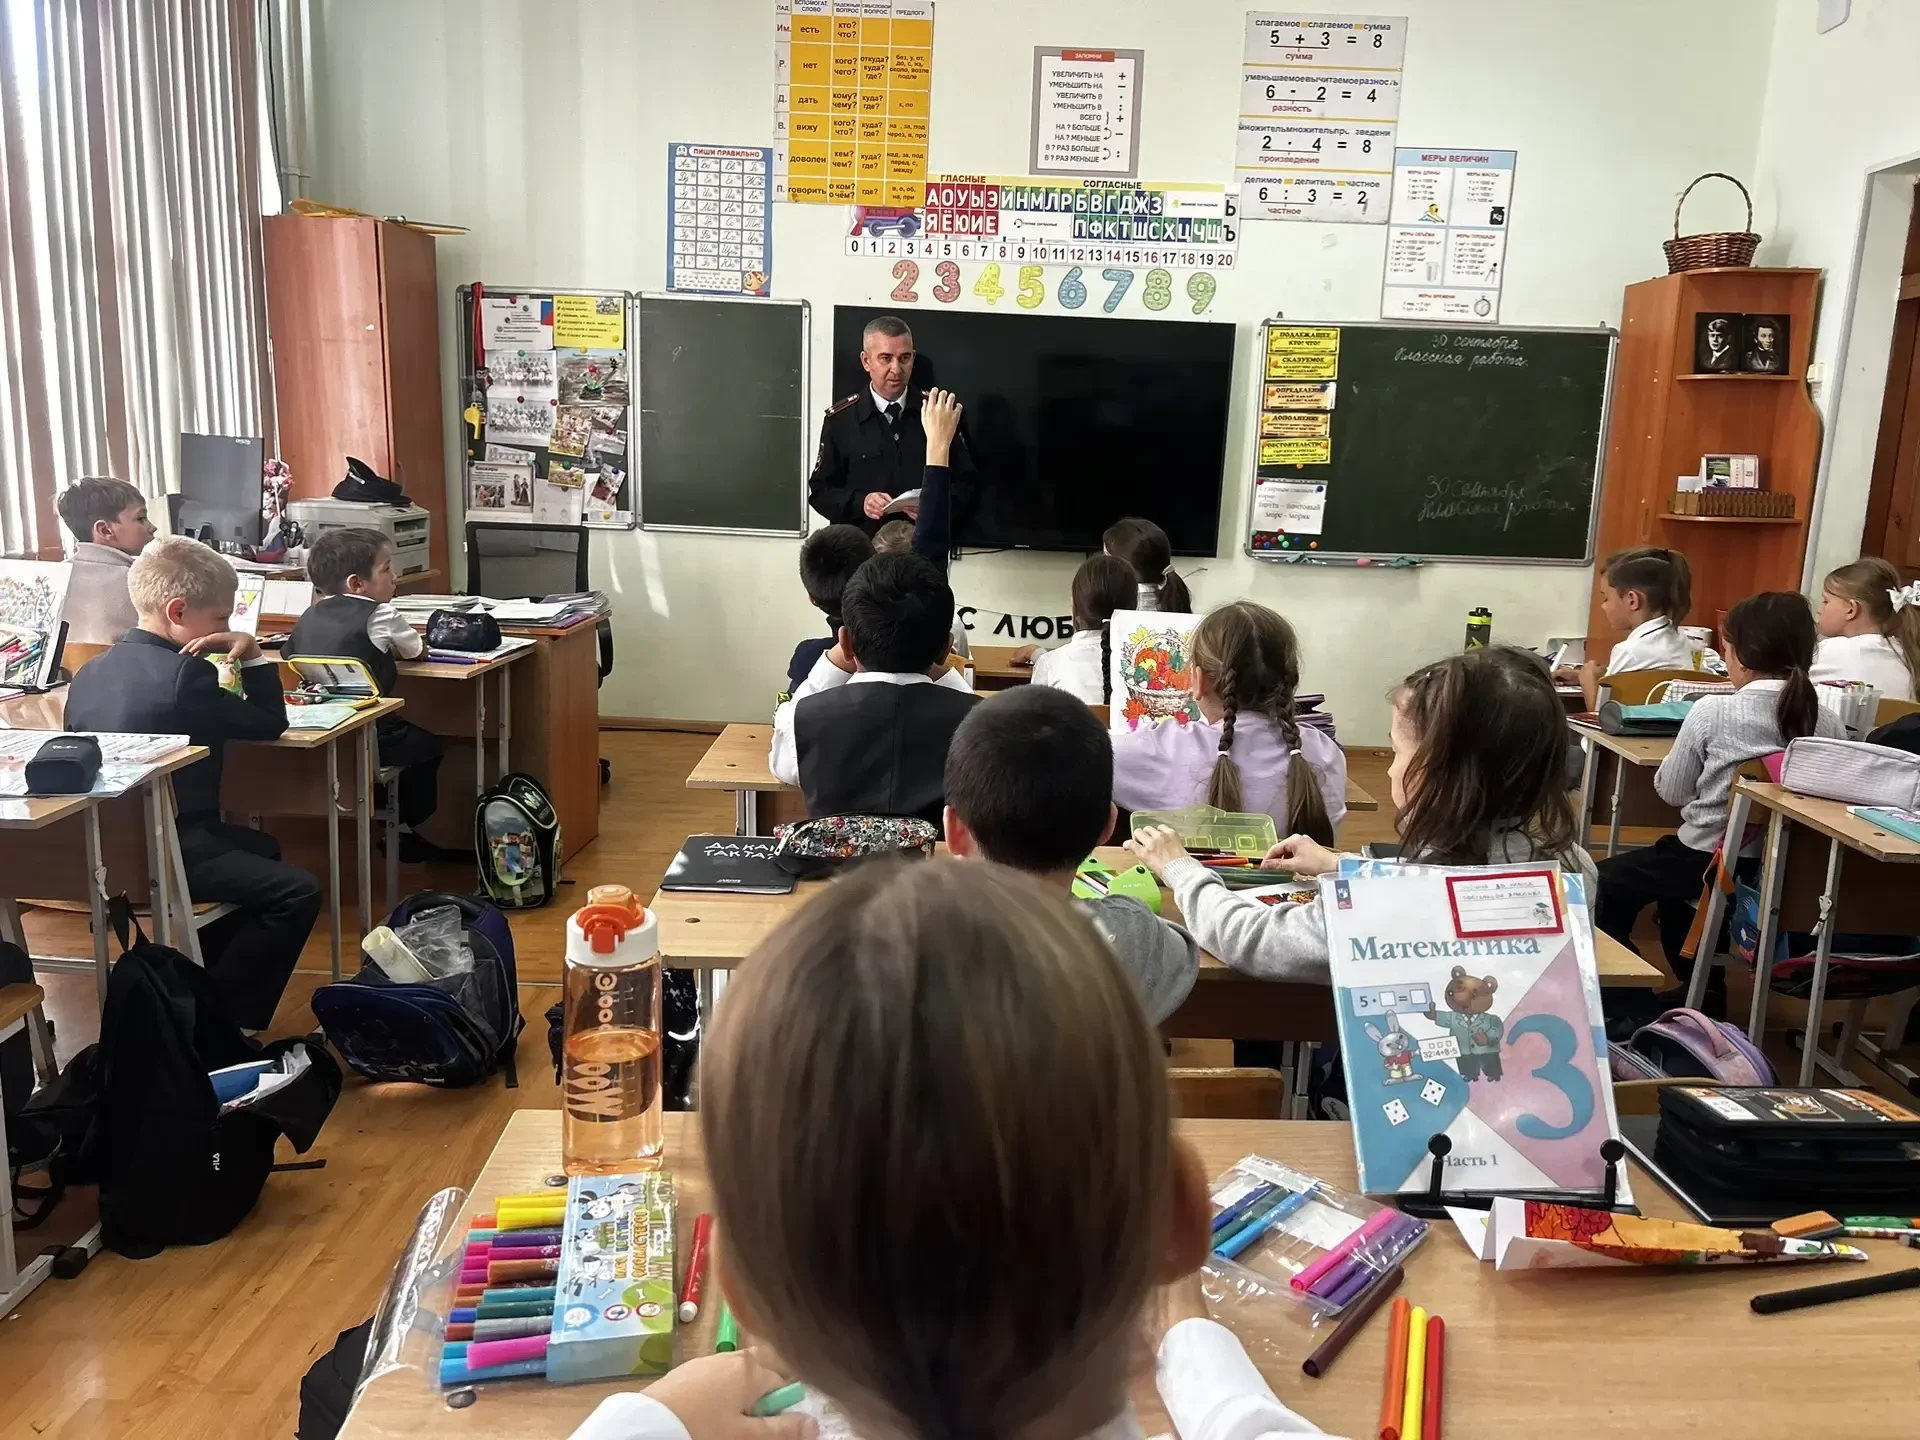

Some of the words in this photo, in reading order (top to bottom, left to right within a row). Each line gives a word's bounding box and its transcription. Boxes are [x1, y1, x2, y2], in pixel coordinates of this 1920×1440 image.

[800, 26, 819, 34] есть
[1256, 19, 1300, 28] слагаемое
[1308, 21, 1353, 30] слагаемое
[1364, 23, 1391, 31] сумма
[1270, 30, 1280, 44] 5
[1321, 32, 1330, 45] 3
[1373, 34, 1382, 48] 8
[1285, 52, 1313, 61] сумма
[778, 95, 787, 103] Д.
[1266, 85, 1275, 99] 6
[1316, 86, 1326, 101] 2
[1367, 89, 1376, 103] 4
[1272, 104, 1312, 113] разность
[796, 124, 818, 132] вижу
[1262, 135, 1272, 149] 2
[1312, 137, 1321, 150] 4
[1362, 139, 1372, 153] 8
[693, 148, 715, 156] ПИШИ
[717, 149, 760, 158] ПРАВИЛЬНО
[1421, 154, 1447, 162] МЕРЫ
[1449, 155, 1489, 163] ВЕЛИЧИН
[1259, 155, 1320, 164] произведение
[940, 174, 986, 183] ГЛАСНЫЕ
[1083, 180, 1142, 189] СОГЛАСНЫЕ
[1244, 175, 1282, 186] делимое
[1294, 178, 1335, 187] делитель
[1346, 180, 1380, 188] частное
[777, 184, 785, 192] П.
[788, 187, 826, 195] говорить
[1259, 187, 1268, 201] 6
[1308, 188, 1317, 203] 3
[1357, 191, 1367, 205] 2
[1268, 207, 1301, 215] частное
[851, 240, 858, 252] 0
[871, 242, 876, 253] 1
[889, 242, 896, 253] 2
[907, 243, 914, 254] 3
[925, 244, 932, 255] 4
[944, 244, 951, 256] 5
[962, 245, 969, 256] 6
[981, 246, 988, 257] 7
[999, 247, 1006, 258] 8
[1018, 247, 1025, 258] 9
[1033, 248, 1047, 259] 10
[1052, 248, 1065, 259] 11
[1070, 249, 1084, 260] 12
[1089, 250, 1102, 261] 13
[1107, 251, 1121, 262] 14
[1125, 251, 1140, 262] 15
[1144, 252, 1158, 263] 16
[1163, 253, 1177, 264] 17
[1181, 253, 1195, 265] 18
[1200, 254, 1213, 265] 19
[1218, 255, 1232, 266] 20
[890, 259, 919, 302] 2
[933, 261, 961, 303] 3
[973, 263, 1004, 305] 4
[1017, 265, 1045, 309] 5
[1058, 266, 1087, 309] 6
[1102, 268, 1134, 313] 7
[1143, 268, 1172, 311] 8
[1187, 271, 1217, 315] 9
[1432, 335, 1447, 348] 30
[1425, 475, 1449, 499] 30
[957, 607, 977, 630] С
[1349, 936, 1541, 962] Математика
[1507, 1013, 1595, 1140] 3
[1491, 1154, 1499, 1166] 1
